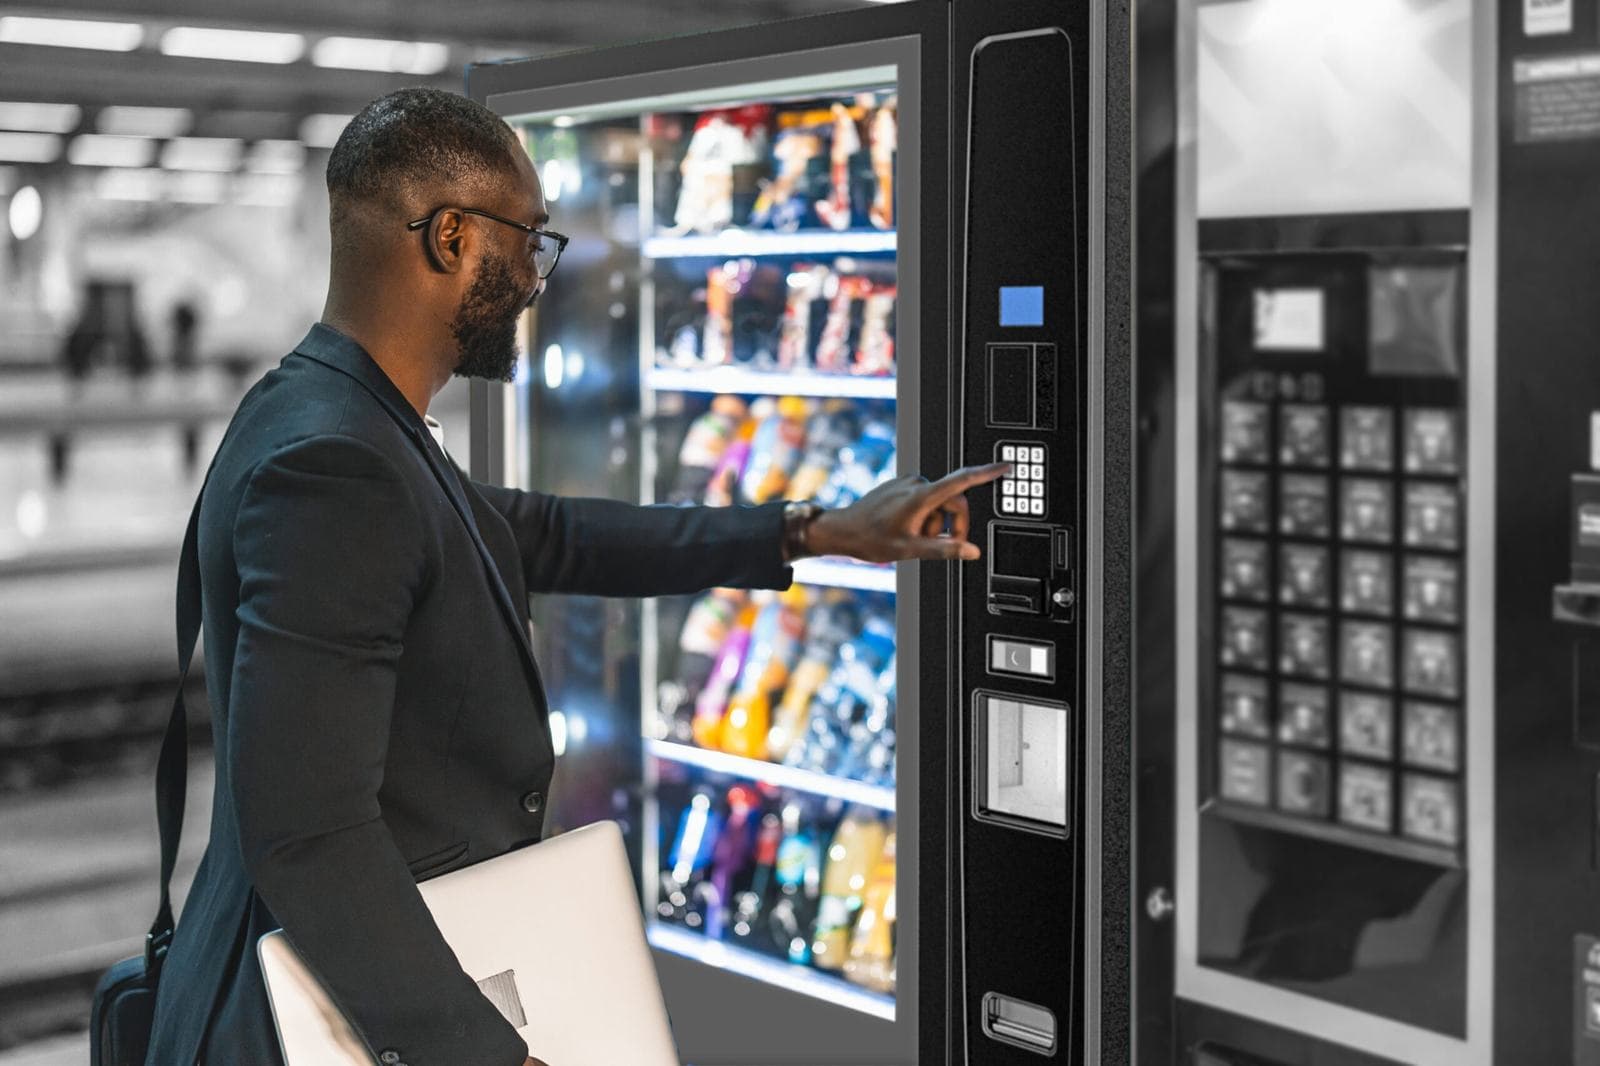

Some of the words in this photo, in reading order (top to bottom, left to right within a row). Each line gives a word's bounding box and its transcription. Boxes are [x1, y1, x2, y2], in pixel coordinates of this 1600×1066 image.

[1020, 450, 1026, 459] 2
[1034, 450, 1040, 459] 3
[1020, 466, 1026, 476] 5
[1034, 467, 1040, 477] 6
[1006, 482, 1012, 492] 7
[1020, 484, 1026, 493] 8
[1034, 485, 1040, 494] 9
[1020, 501, 1026, 510] 0
